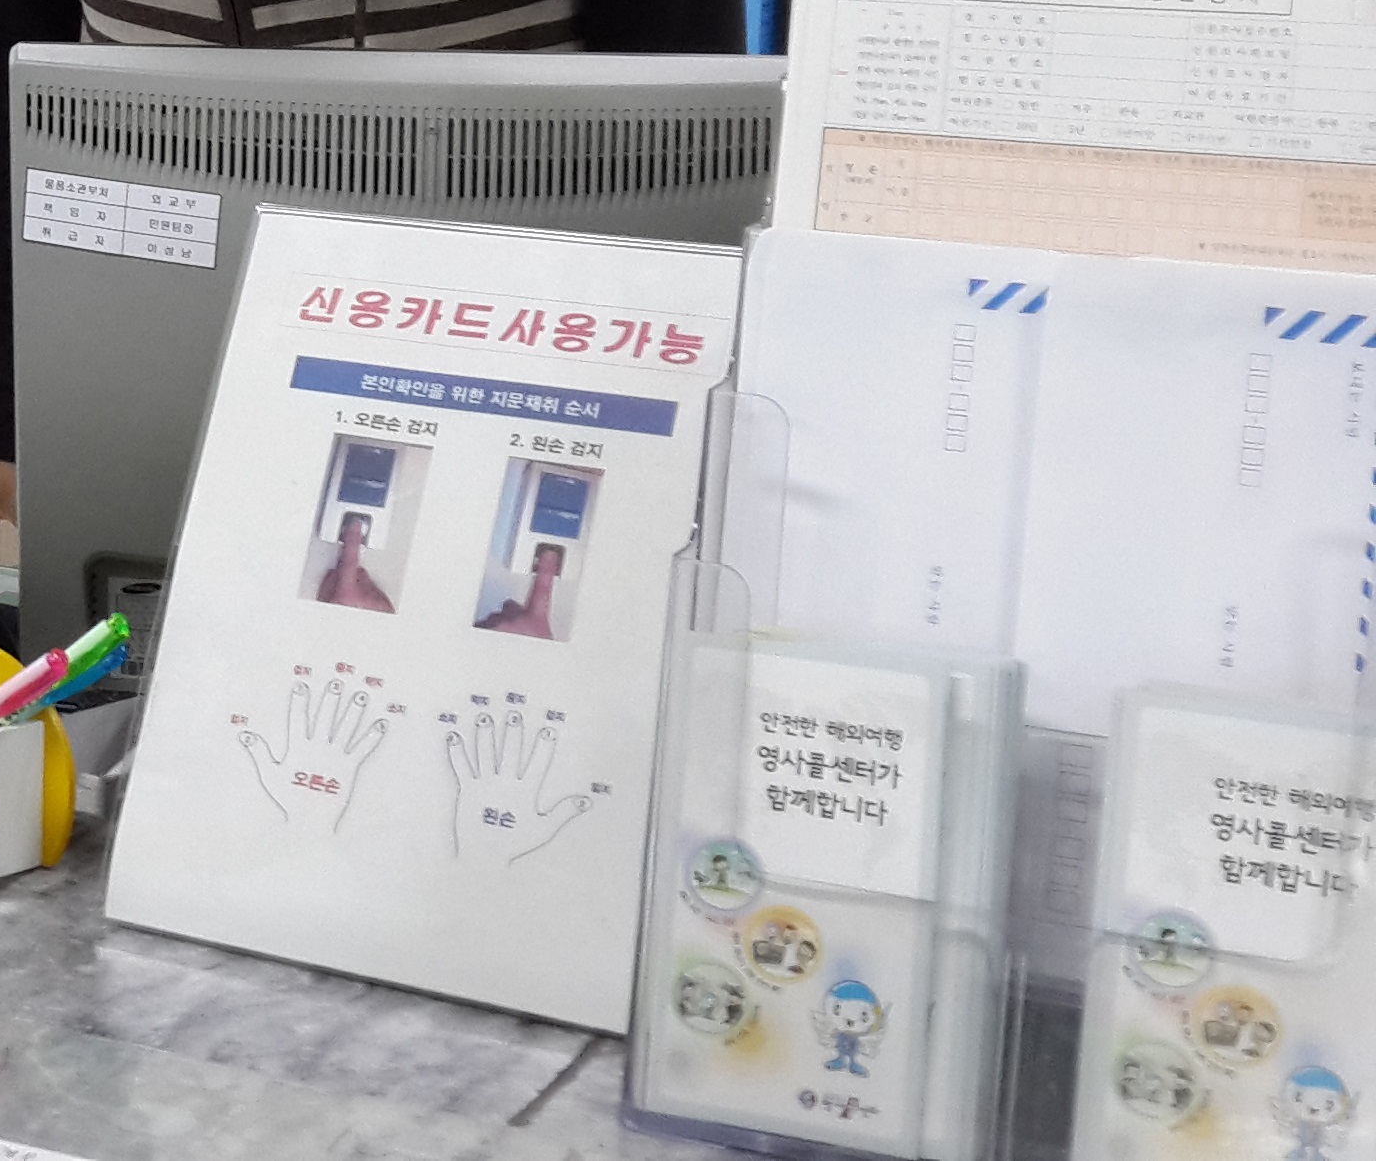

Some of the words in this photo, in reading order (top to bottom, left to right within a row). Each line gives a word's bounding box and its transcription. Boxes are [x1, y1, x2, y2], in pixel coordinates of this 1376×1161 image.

[298, 285, 705, 366] 신용카드사용가능
[360, 372, 446, 402] 본인확인을
[451, 384, 486, 405] 위한
[490, 388, 561, 417] 지문채취
[565, 396, 601, 419] 순서
[354, 411, 401, 434] 오른손
[405, 416, 439, 437] 검지
[531, 436, 566, 456] 왼손
[570, 439, 604, 460] 검지
[759, 711, 819, 740] 안전한
[825, 720, 905, 751] 해외여행
[756, 745, 903, 789] 영사콜센터가
[766, 785, 889, 827] 함께합니다
[1215, 777, 1280, 807] 안전한
